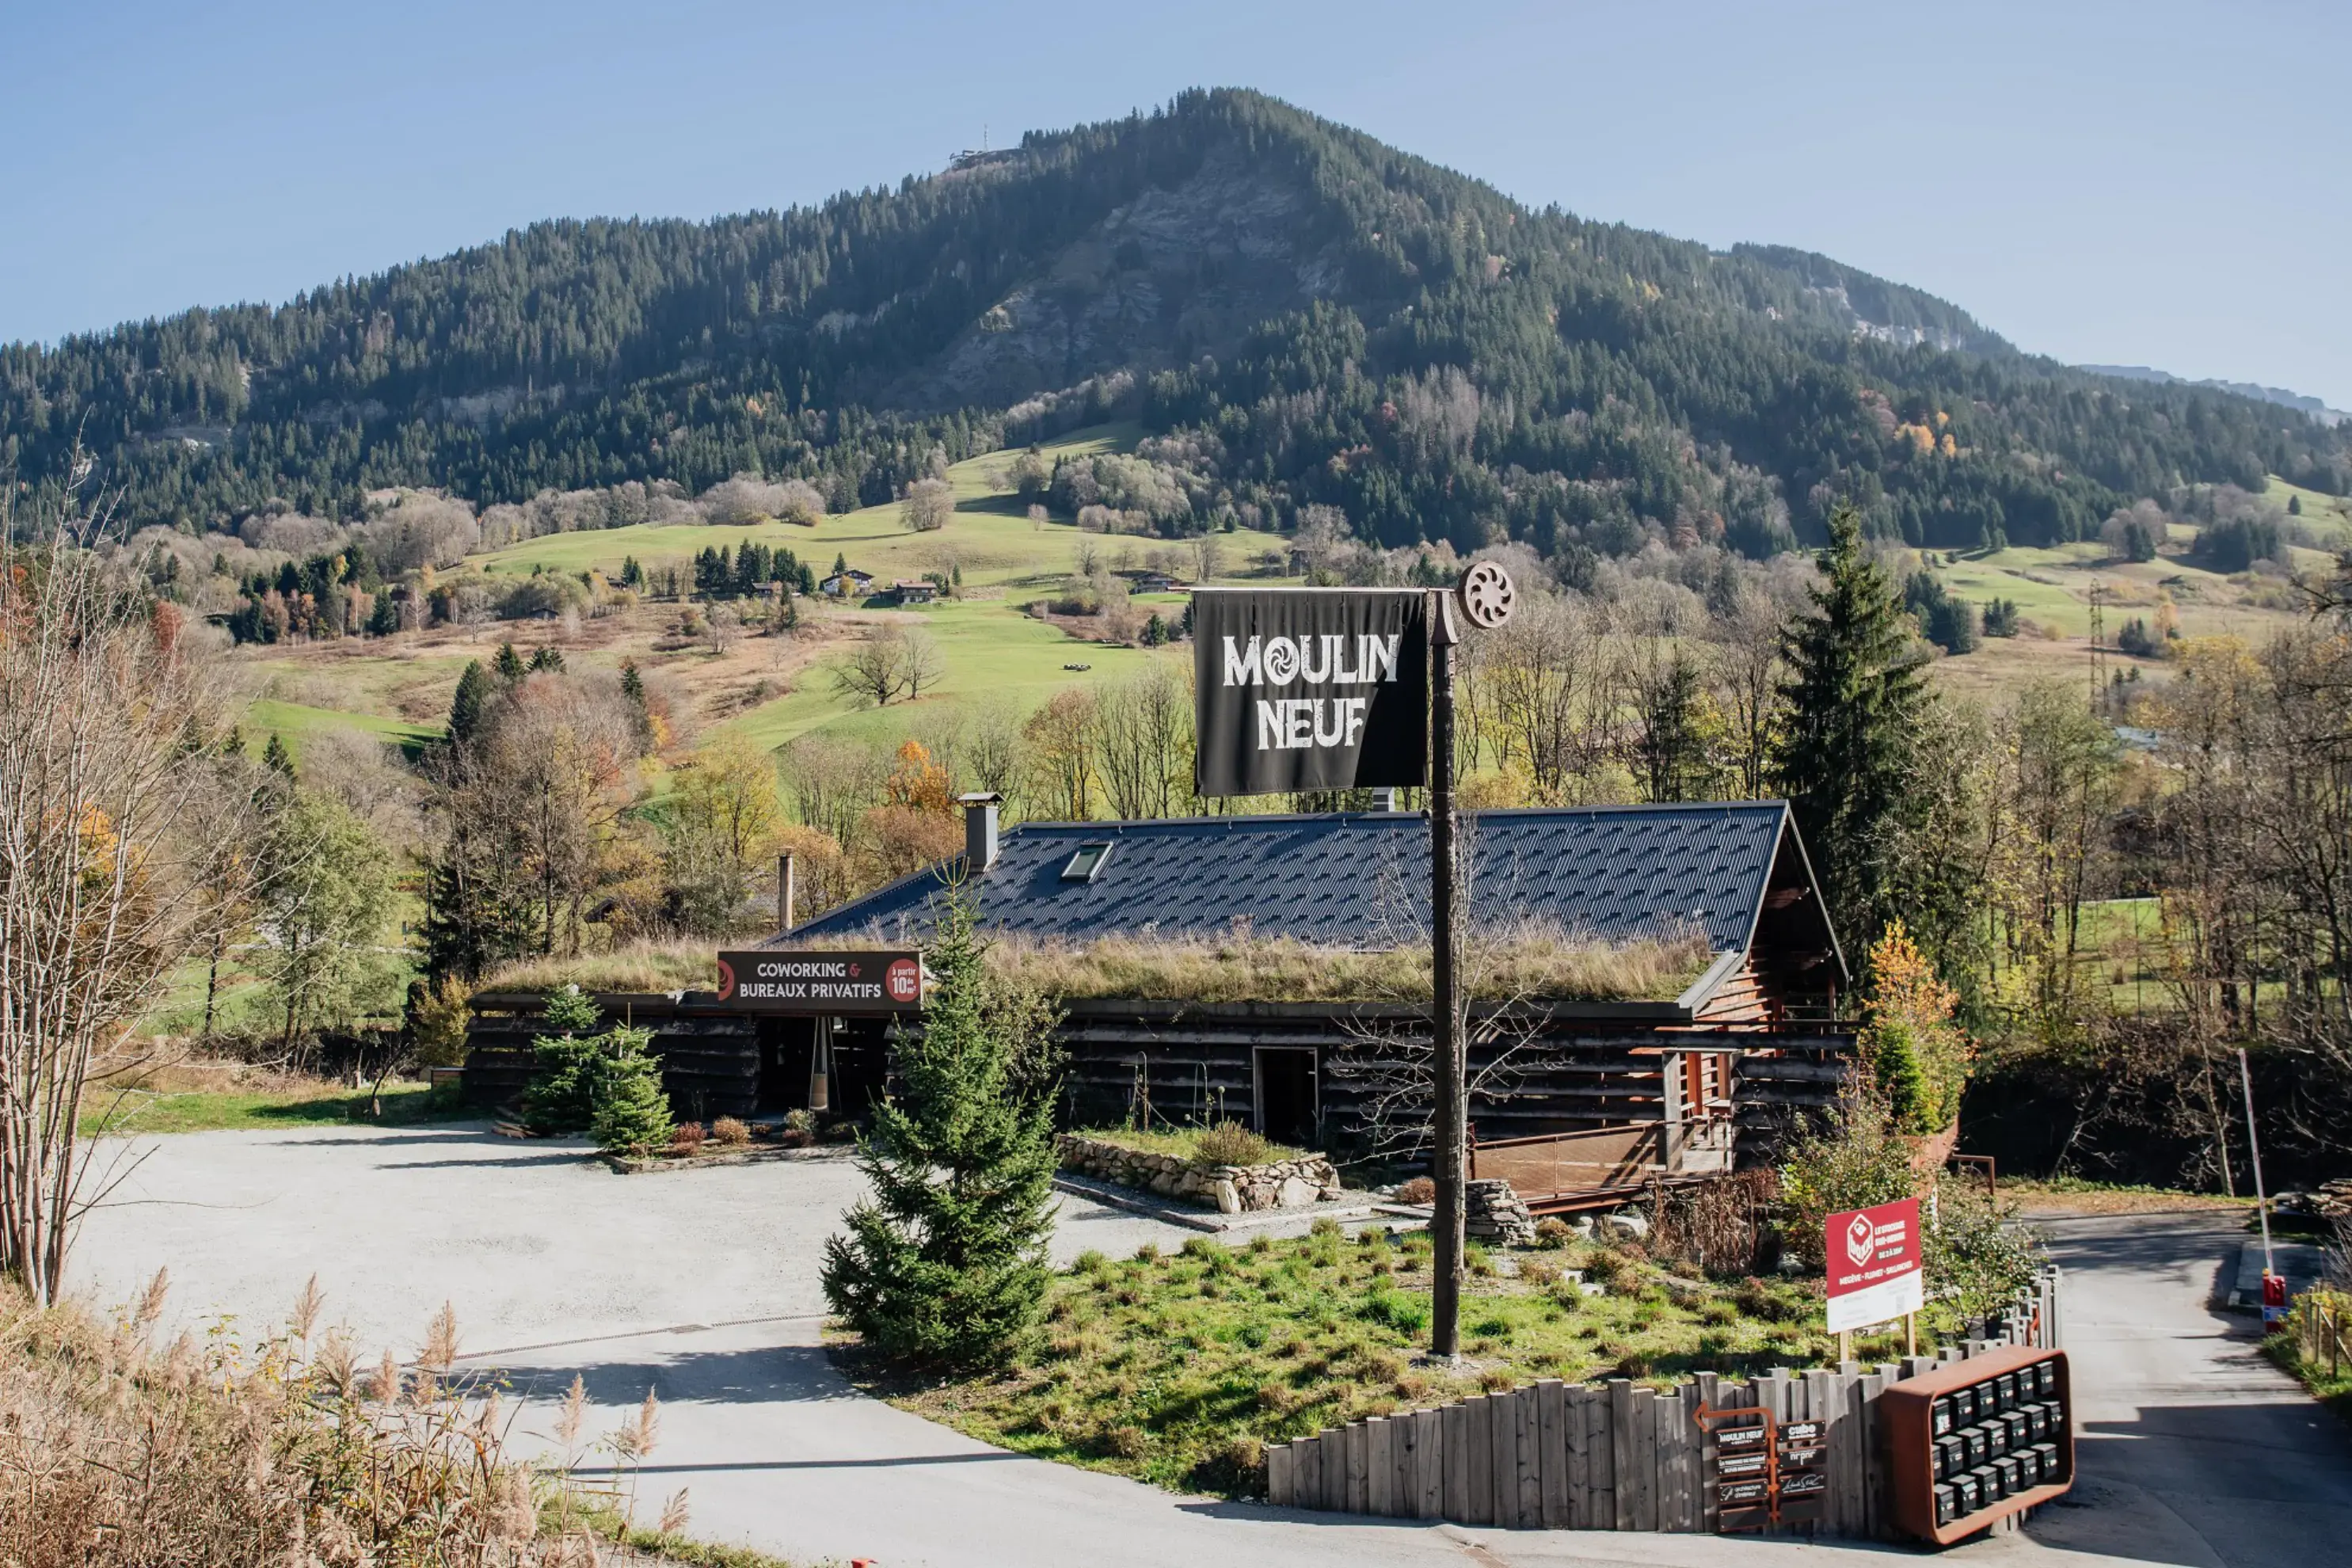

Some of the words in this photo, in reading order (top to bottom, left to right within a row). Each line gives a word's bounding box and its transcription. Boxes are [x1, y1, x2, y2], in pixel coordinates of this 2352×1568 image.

[1223, 634, 1399, 686] MOULIN
[1257, 698, 1365, 750] NEUF
[757, 963, 846, 977] COWORKING
[849, 964, 862, 977] &
[892, 966, 896, 976] à
[897, 966, 916, 977] partir
[740, 984, 806, 998] BUREAUX
[811, 983, 881, 998] PRIVATIFS
[892, 976, 907, 994] 10
[1840, 1273, 1862, 1285] MEGÈVE
[1720, 1432, 1745, 1443] MOULIN
[1746, 1429, 1763, 1439] NEUF
